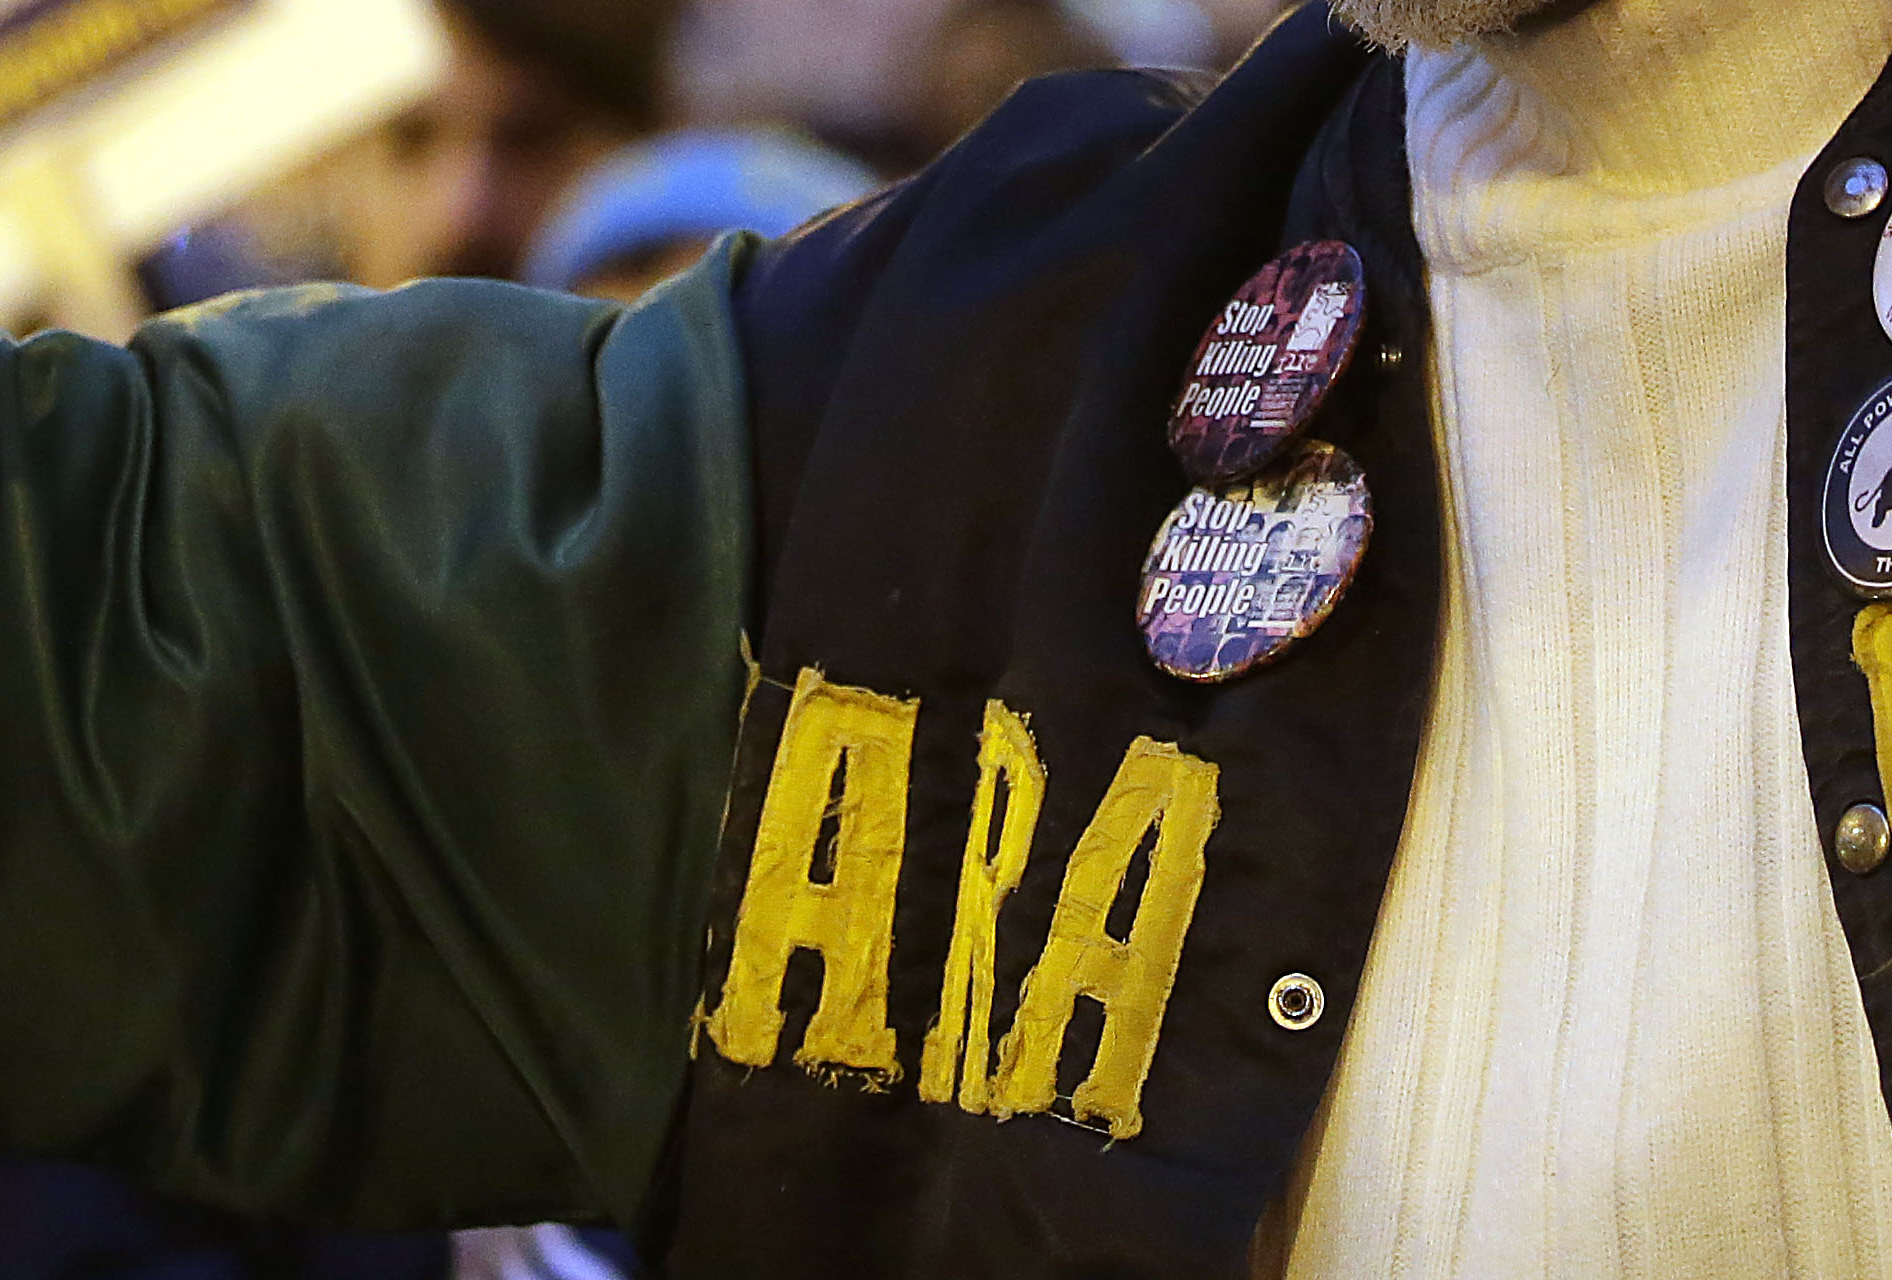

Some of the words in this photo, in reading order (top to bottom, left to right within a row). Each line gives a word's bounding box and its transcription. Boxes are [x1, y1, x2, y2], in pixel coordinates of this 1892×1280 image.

[1217, 300, 1275, 336] Stop
[1196, 340, 1278, 377] Killing
[1177, 380, 1261, 420] People
[1839, 434, 1864, 474] ALL
[1177, 493, 1255, 533] Stop
[1160, 535, 1269, 575] Killing
[1144, 577, 1255, 619] People
[691, 635, 1222, 1142] ARA
